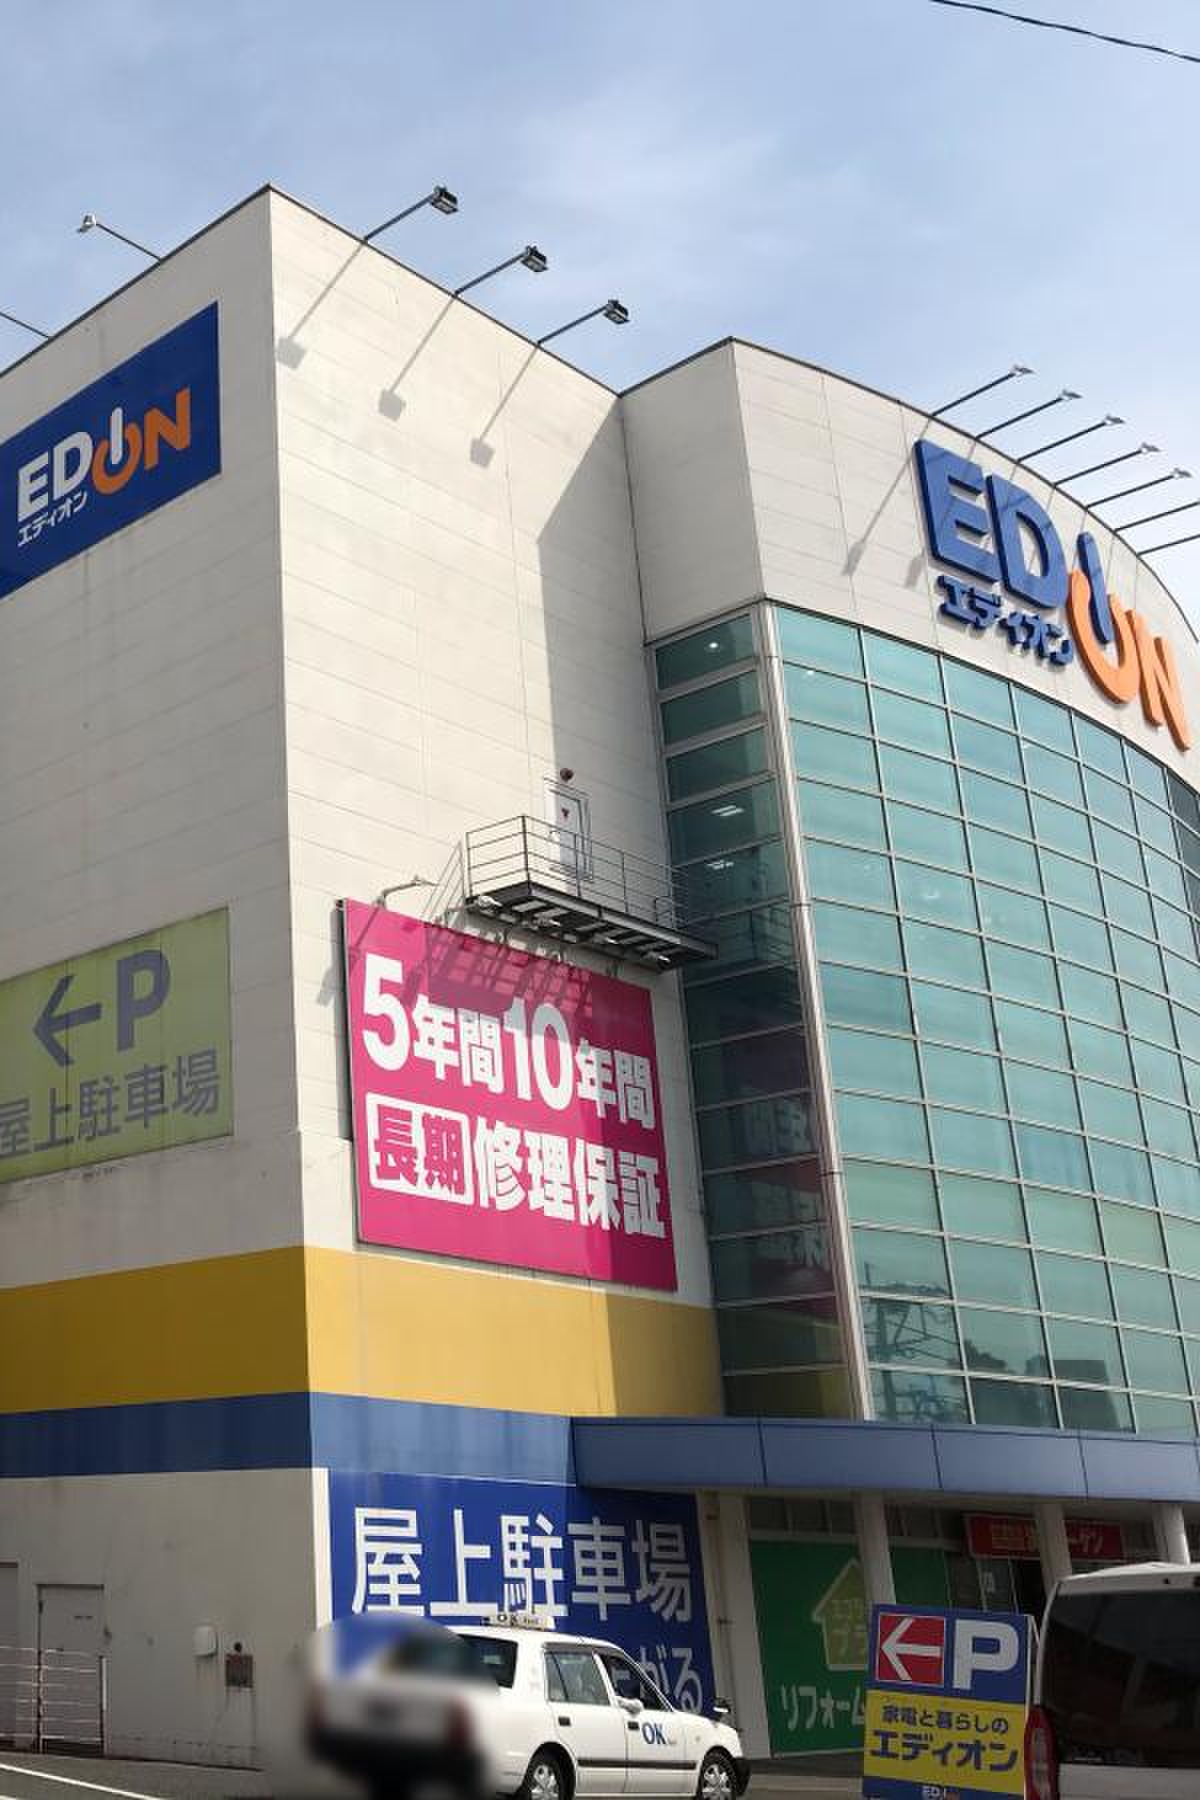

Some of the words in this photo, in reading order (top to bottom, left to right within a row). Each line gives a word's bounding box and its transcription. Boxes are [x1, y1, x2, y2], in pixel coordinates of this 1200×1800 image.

[17, 388, 191, 523] EDION
[17, 490, 88, 547] エディオン
[913, 439, 1191, 754] EDION
[936, 574, 1074, 667] エディオン
[116, 949, 171, 1052] P
[351, 1505, 694, 1623] 屋上駐車場
[952, 1619, 1019, 1690] P
[641, 1721, 667, 1745] OK
[869, 1729, 1019, 1773] エディオン
[881, 1704, 1009, 1735] 家電と暮らしの
